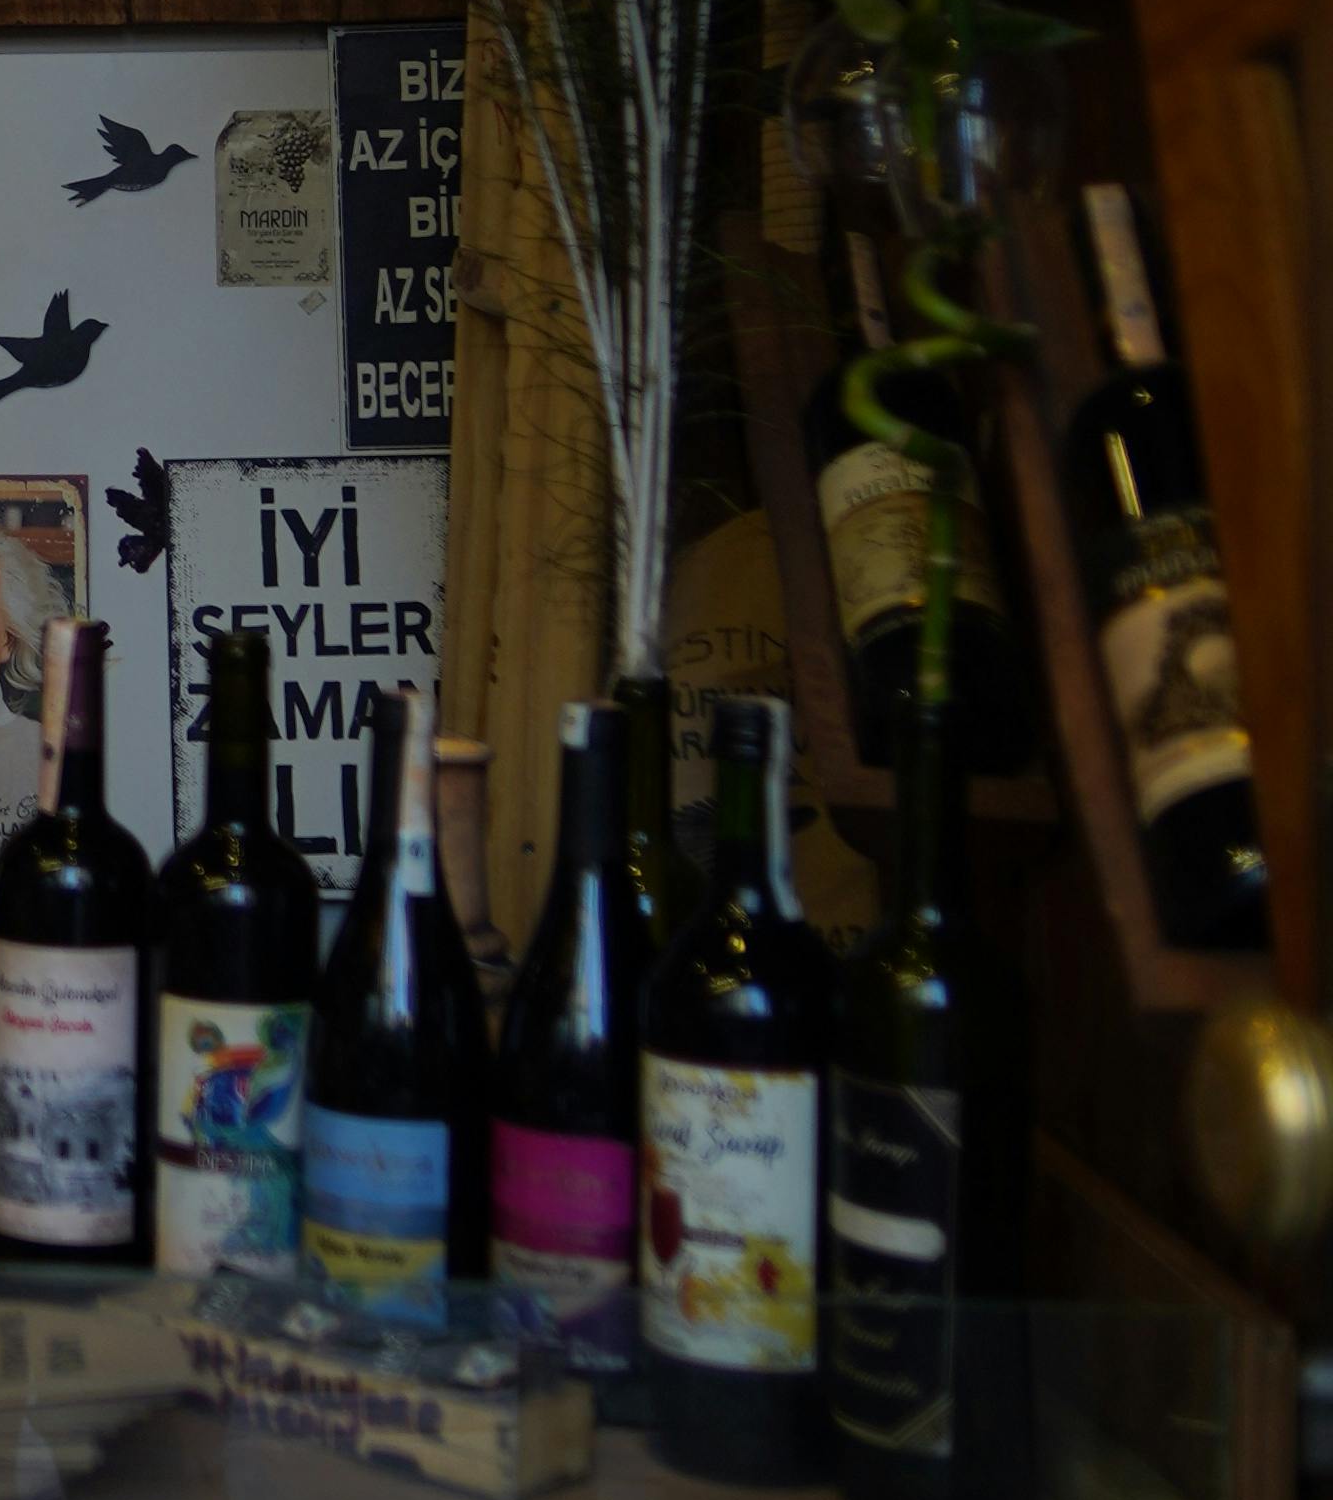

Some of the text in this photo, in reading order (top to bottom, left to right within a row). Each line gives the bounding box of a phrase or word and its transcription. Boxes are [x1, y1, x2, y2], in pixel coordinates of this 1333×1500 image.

[349, 117, 462, 179] AZ İÇ
[240, 205, 308, 229] MARDİN
[374, 267, 417, 325] AZ
[260, 486, 361, 588] İYİ
